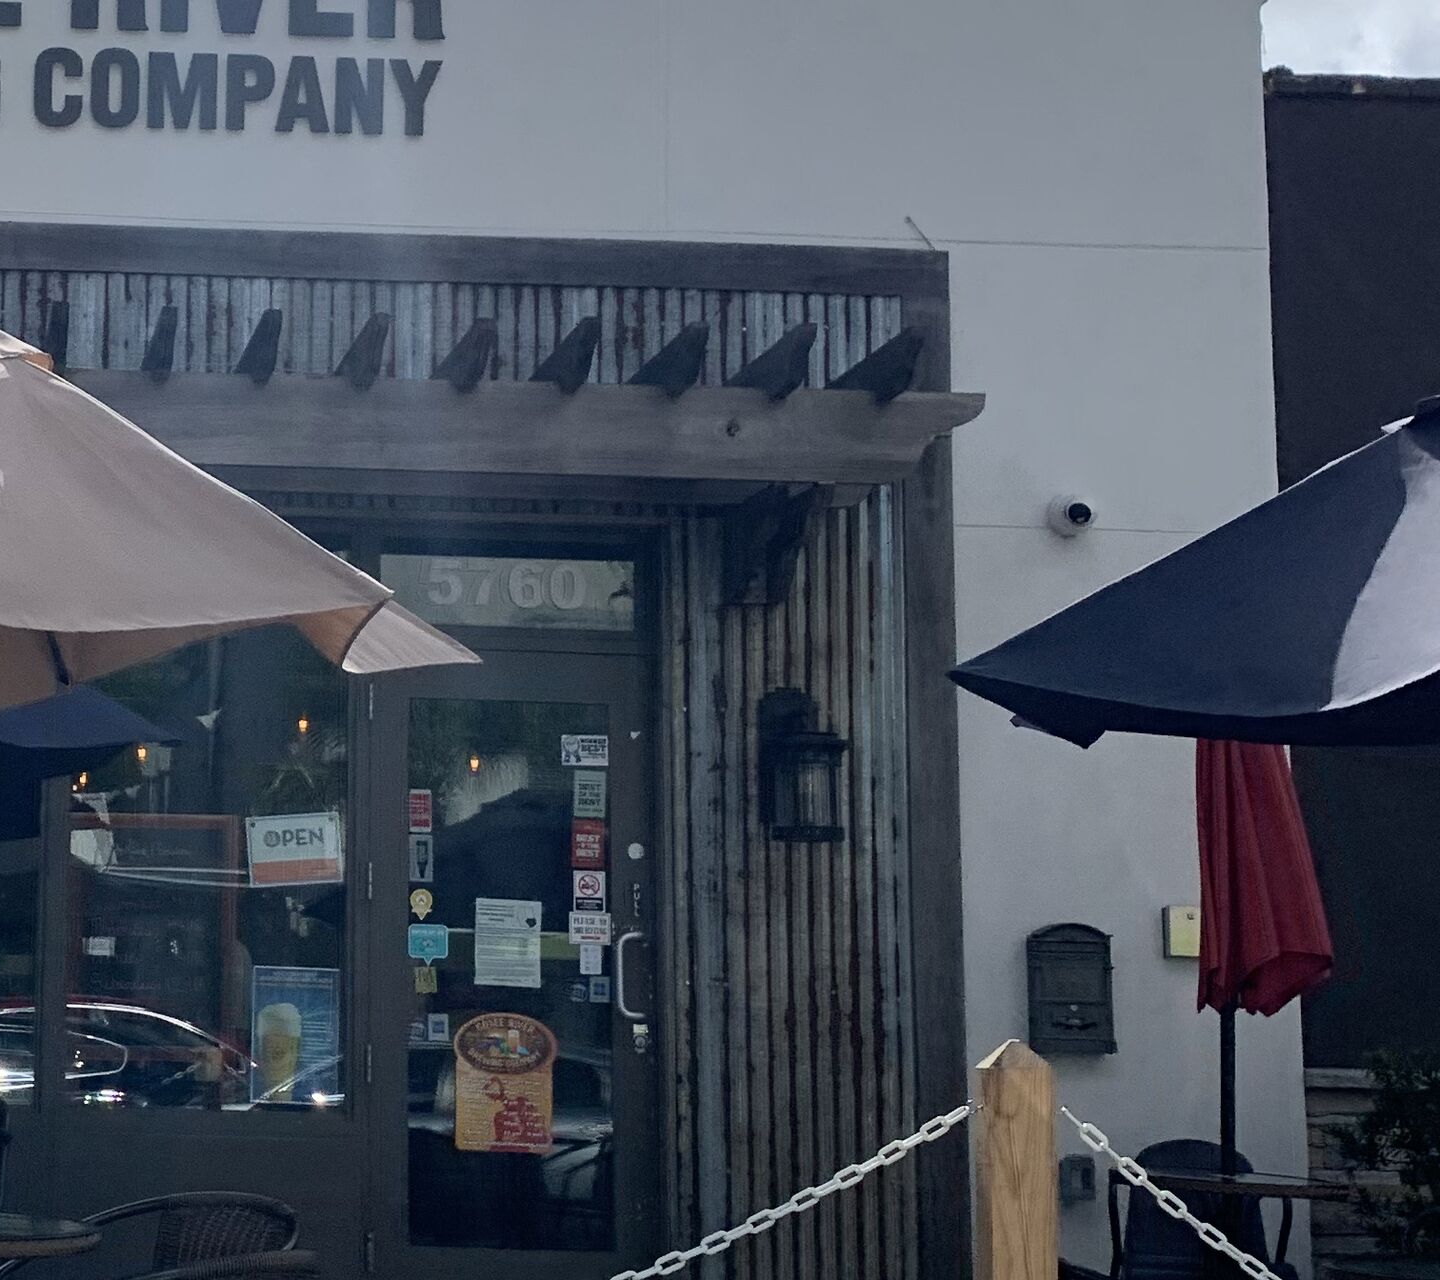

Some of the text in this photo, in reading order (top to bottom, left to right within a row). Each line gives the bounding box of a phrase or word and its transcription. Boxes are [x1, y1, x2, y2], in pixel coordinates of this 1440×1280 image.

[32, 47, 444, 136] COMPANY
[428, 558, 585, 610] 5760
[263, 827, 324, 848] OPEN
